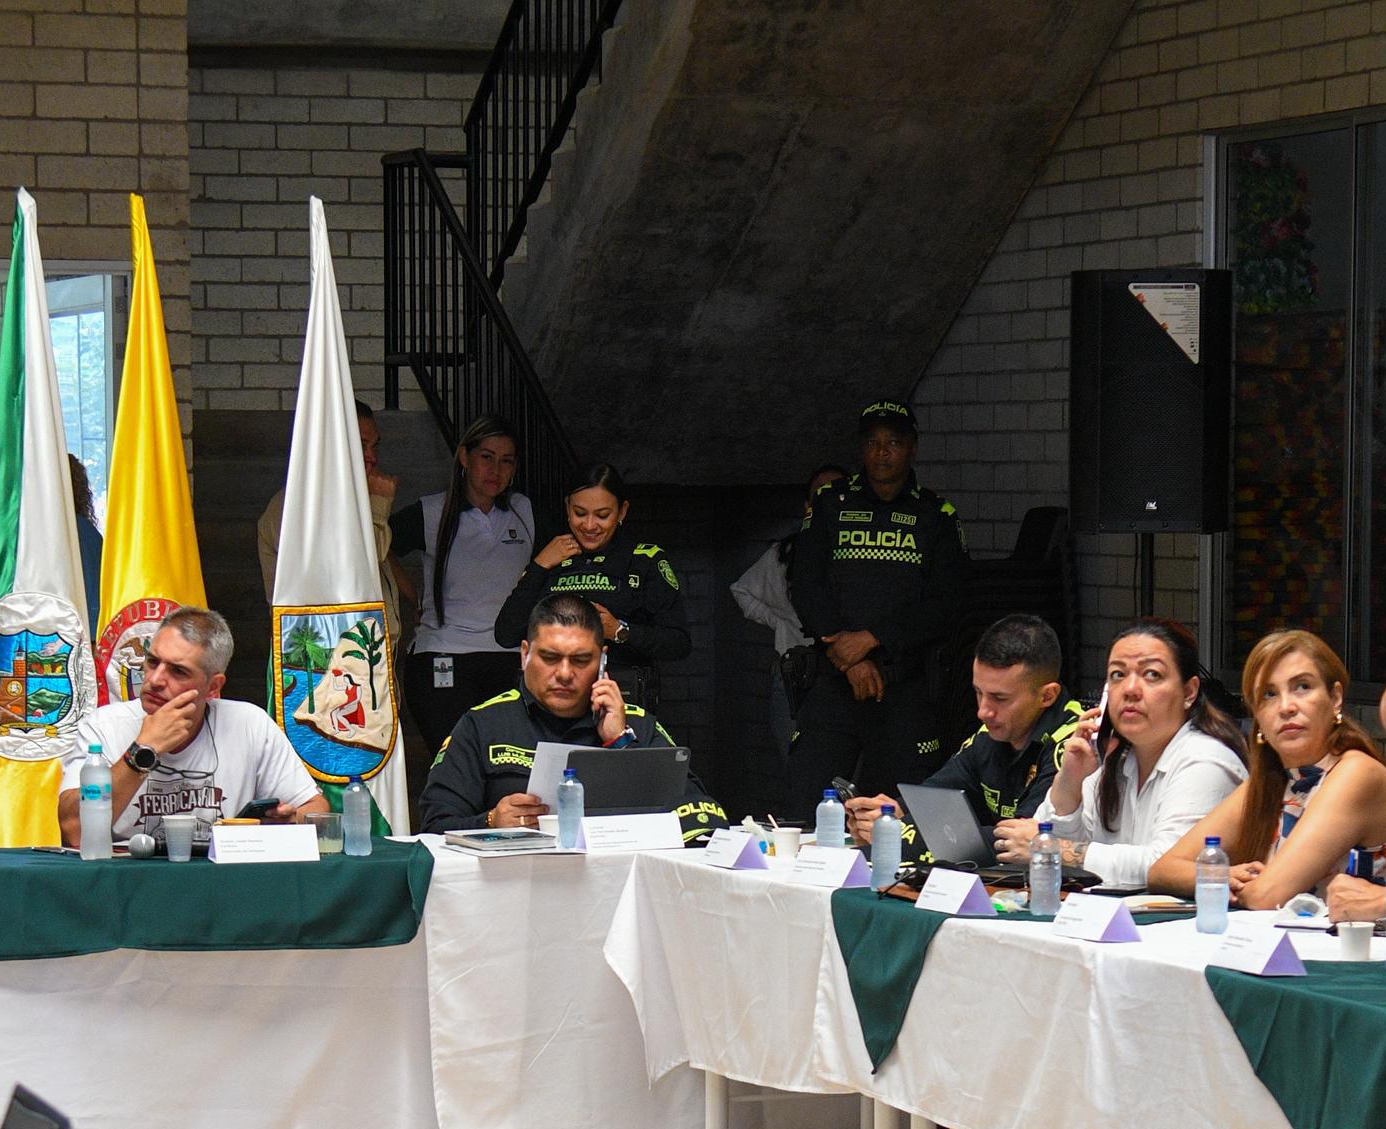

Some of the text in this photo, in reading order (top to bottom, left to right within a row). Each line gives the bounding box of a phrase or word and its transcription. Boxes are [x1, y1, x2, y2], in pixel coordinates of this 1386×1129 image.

[838, 529, 917, 549] POLICÍA
[558, 572, 610, 586] POLICÍA
[676, 802, 728, 821] OLICÍA
